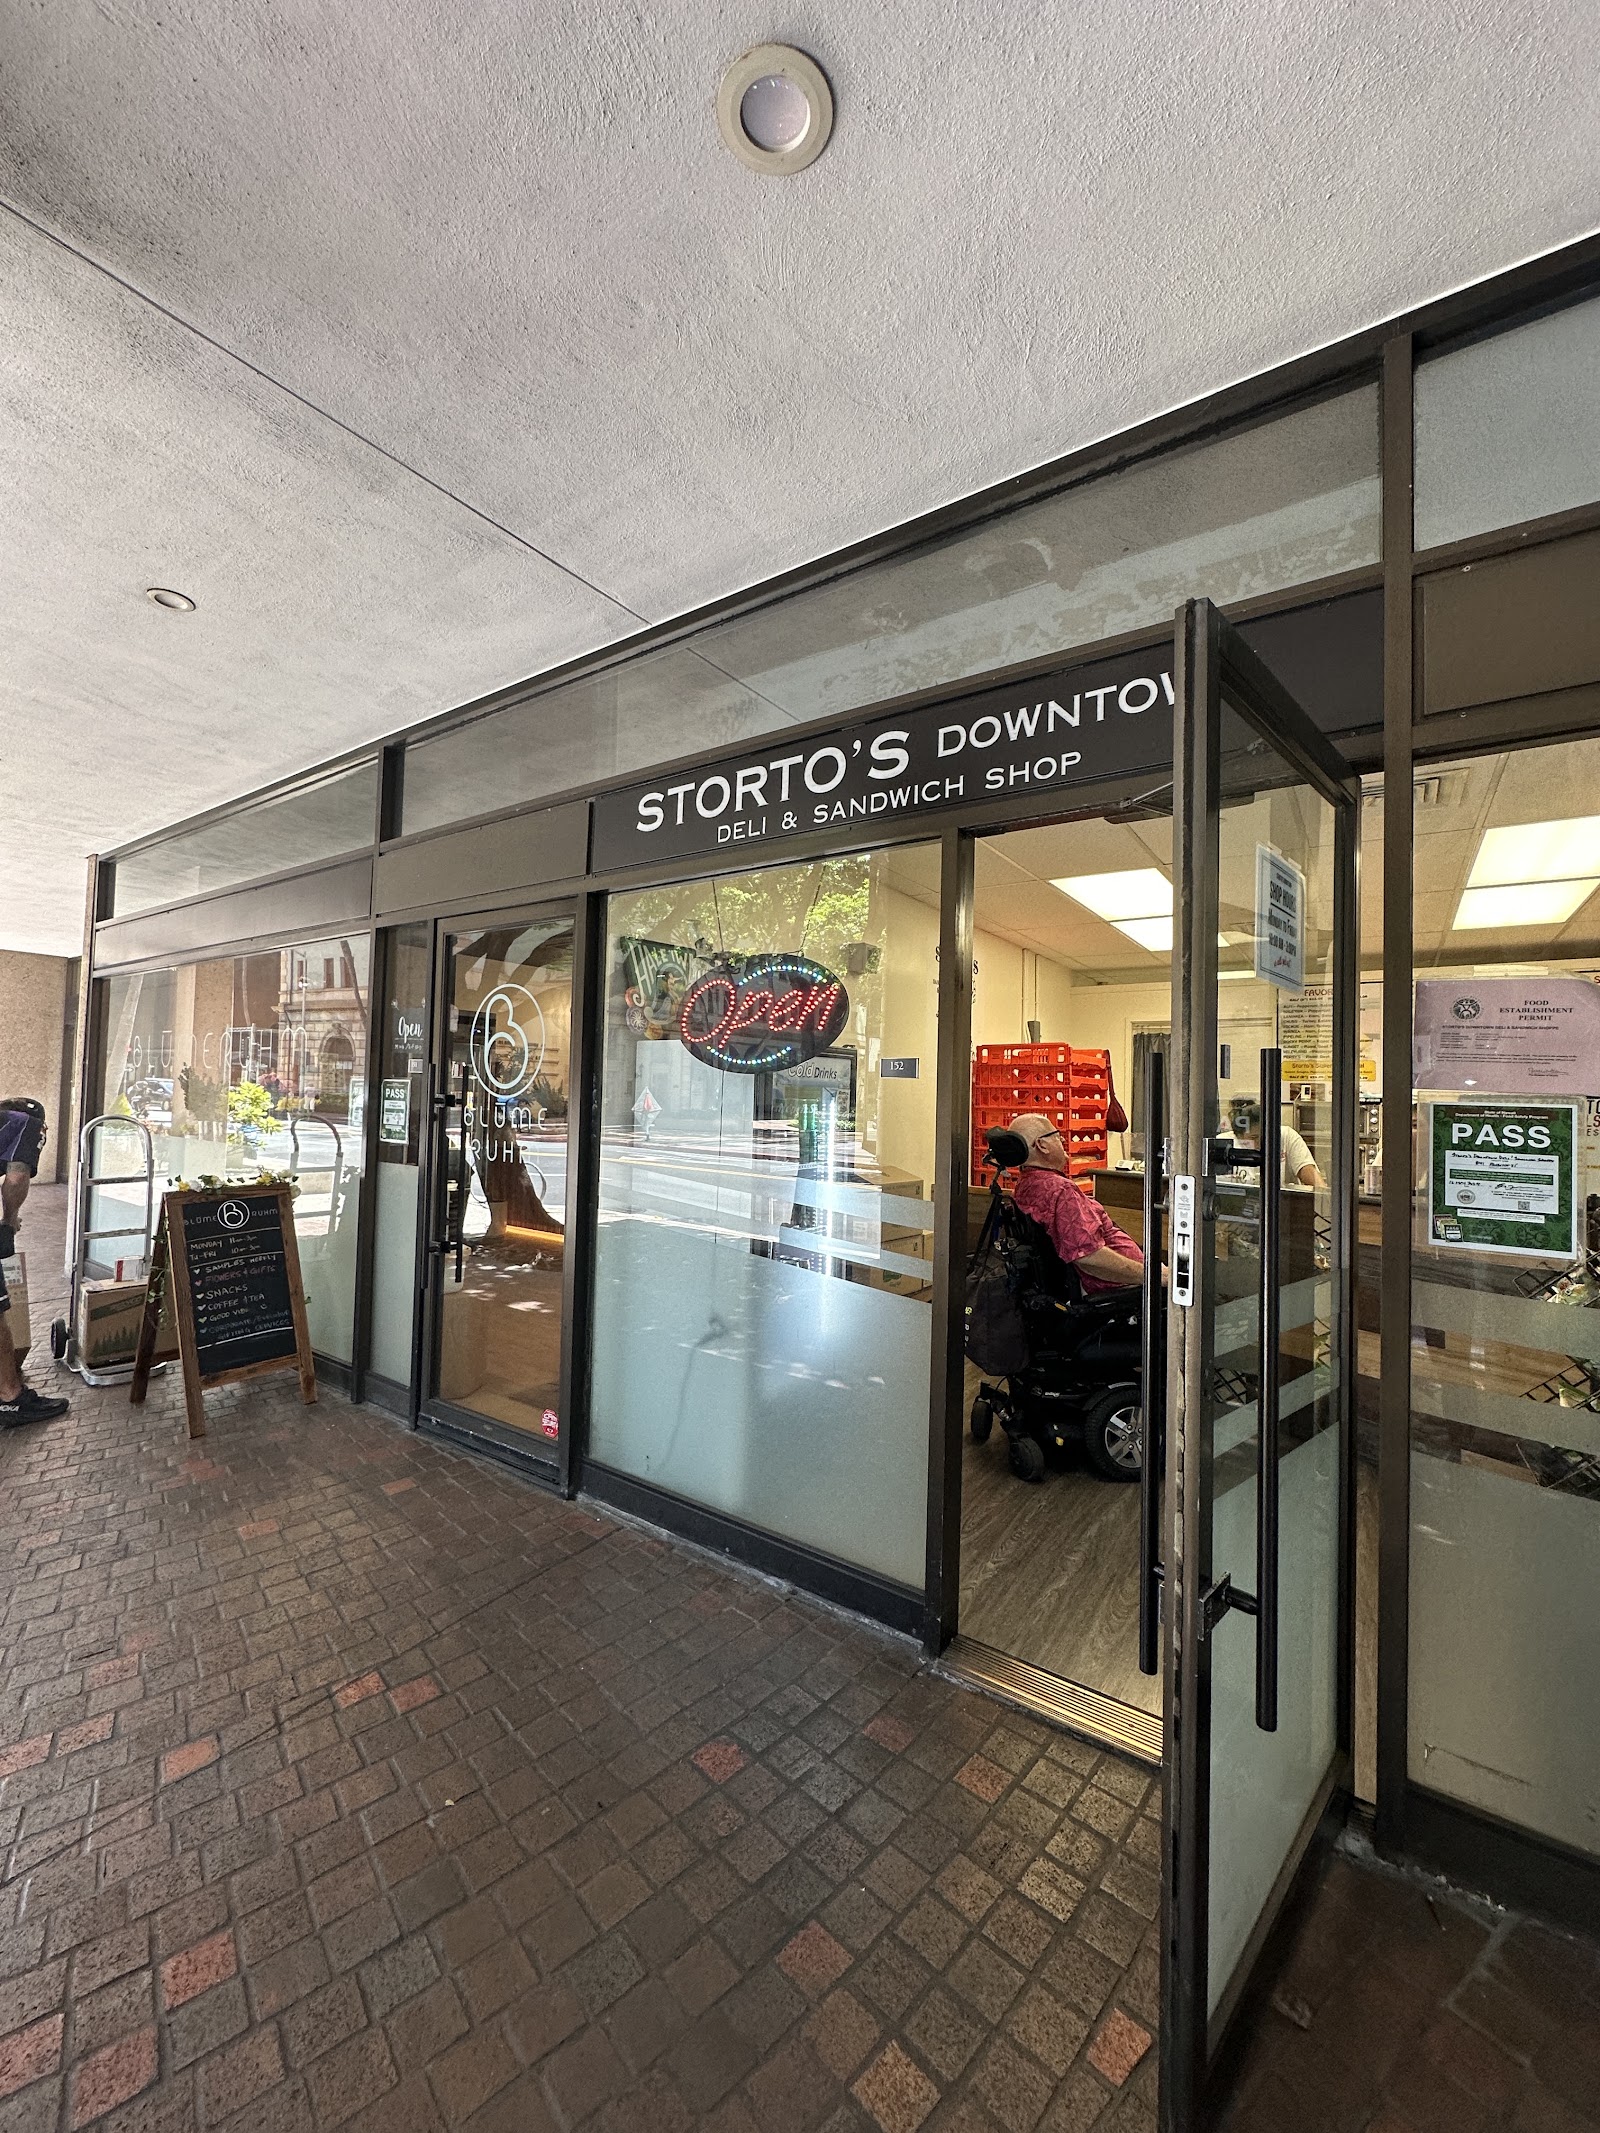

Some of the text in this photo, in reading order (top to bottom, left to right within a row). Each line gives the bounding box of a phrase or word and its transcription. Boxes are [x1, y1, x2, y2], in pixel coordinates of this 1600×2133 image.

[636, 671, 1174, 832] STORTO'S DOWNTO
[716, 751, 1083, 843] DELI & SANDWICH SHOP
[681, 979, 840, 1049] Open
[398, 1016, 424, 1045] Open
[814, 1067, 838, 1080] Drinks
[889, 1061, 904, 1071] 152
[385, 1088, 405, 1098] PASS
[1452, 1123, 1551, 1149] PASS
[190, 1240, 223, 1250] MONDAY
[205, 1259, 245, 1273] SAMPLES
[205, 1283, 249, 1299] SNACKS
[208, 1298, 239, 1311] COFFEE
[249, 1293, 265, 1302] TEA
[209, 1311, 230, 1322] GOOD
